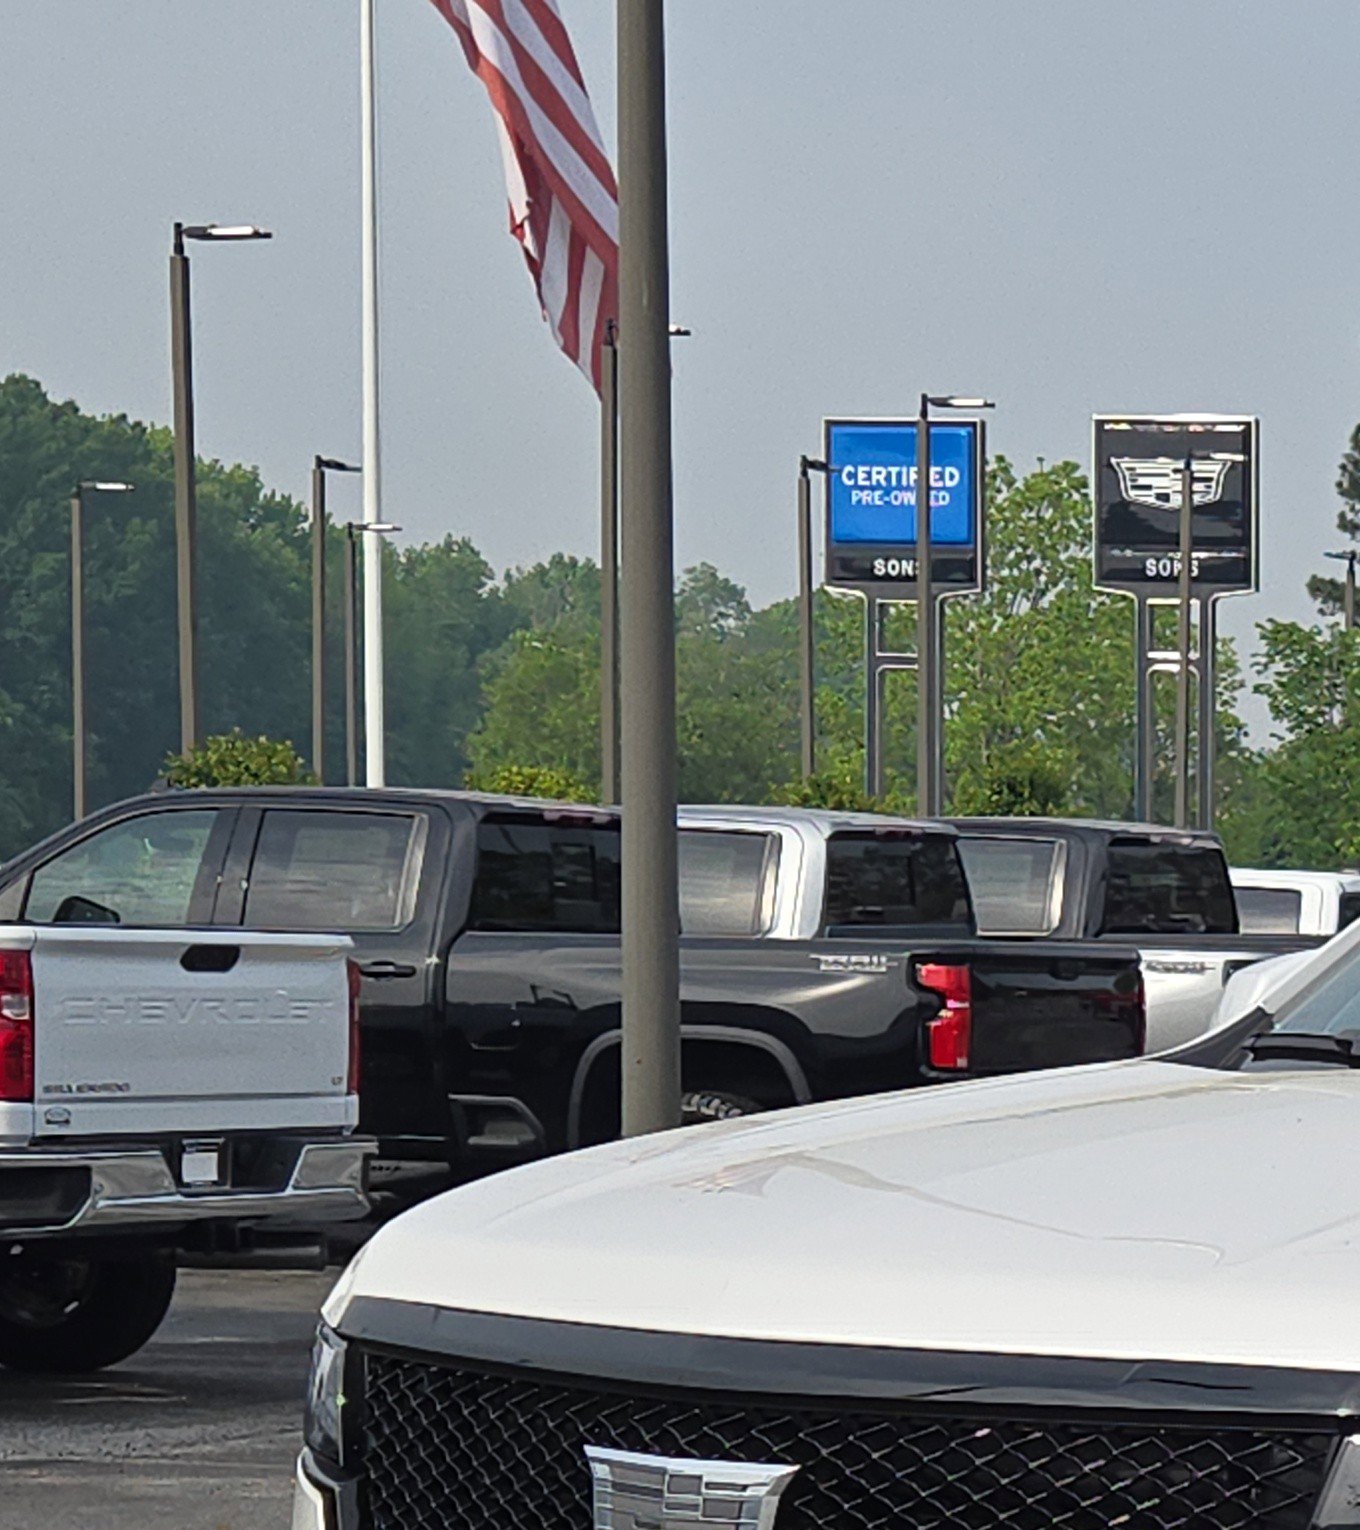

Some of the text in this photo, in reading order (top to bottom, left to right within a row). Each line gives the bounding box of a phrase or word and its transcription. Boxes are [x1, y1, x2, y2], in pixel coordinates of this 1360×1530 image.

[841, 465, 960, 487] CERTIFED
[851, 490, 950, 507] PRE-OWED
[60, 996, 334, 1026] CHEVROLET
